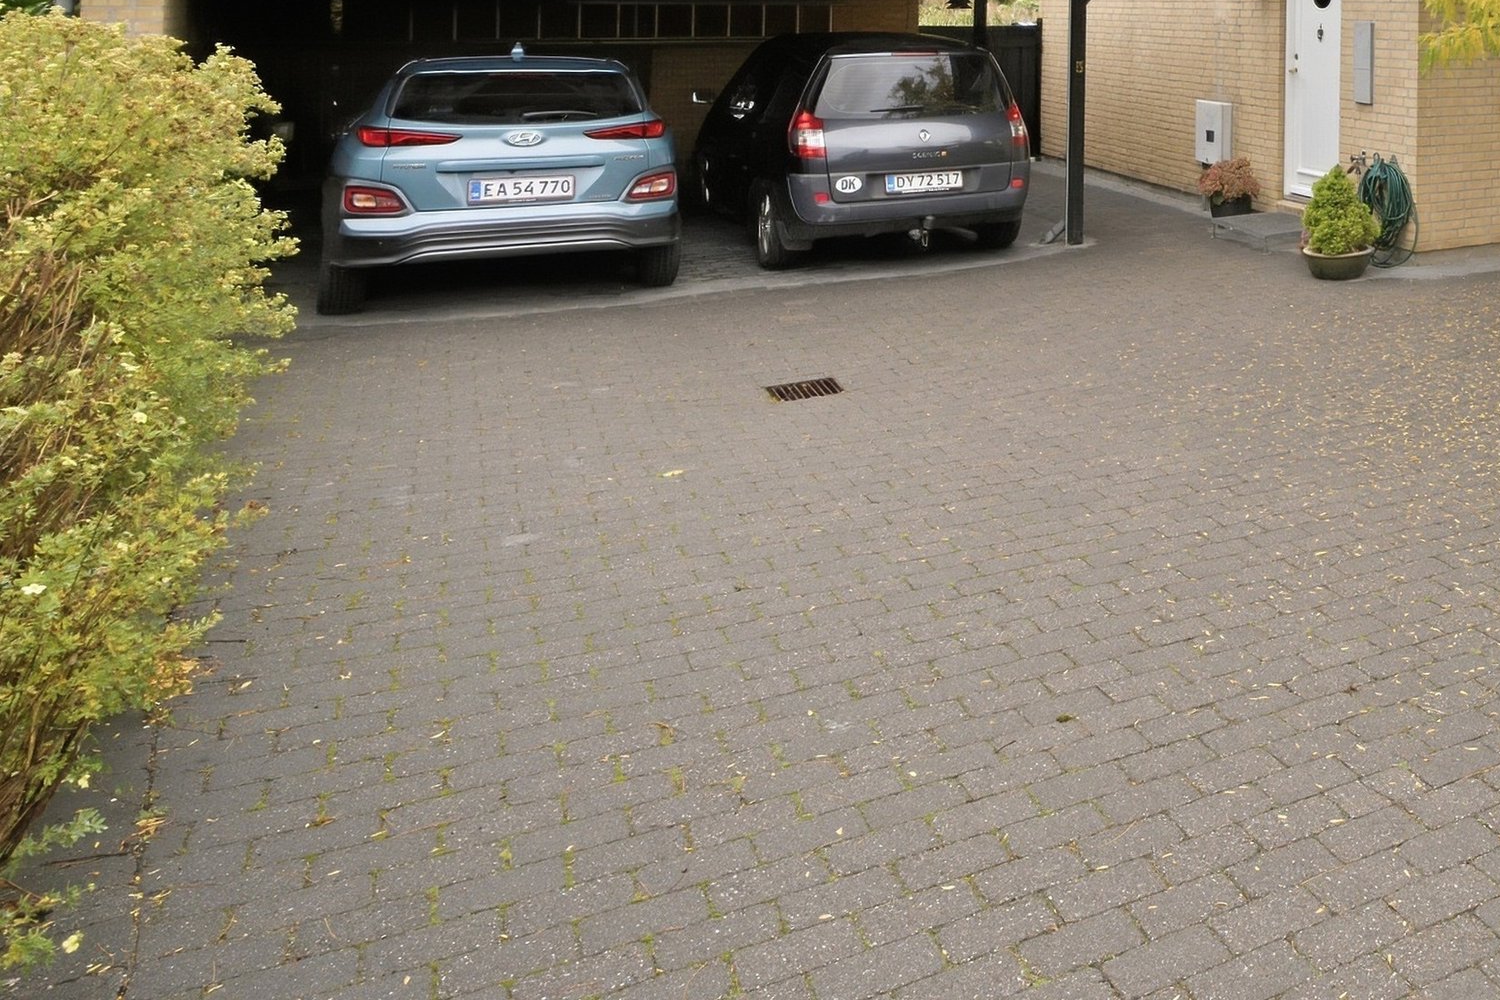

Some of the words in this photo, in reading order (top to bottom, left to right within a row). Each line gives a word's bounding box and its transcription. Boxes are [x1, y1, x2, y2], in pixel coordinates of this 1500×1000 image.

[484, 183, 507, 197] EA
[513, 181, 534, 196] 54
[539, 179, 570, 194] 770
[841, 178, 856, 190] DK
[896, 176, 914, 188] DY
[917, 174, 934, 186] 72
[937, 172, 960, 185] 517
